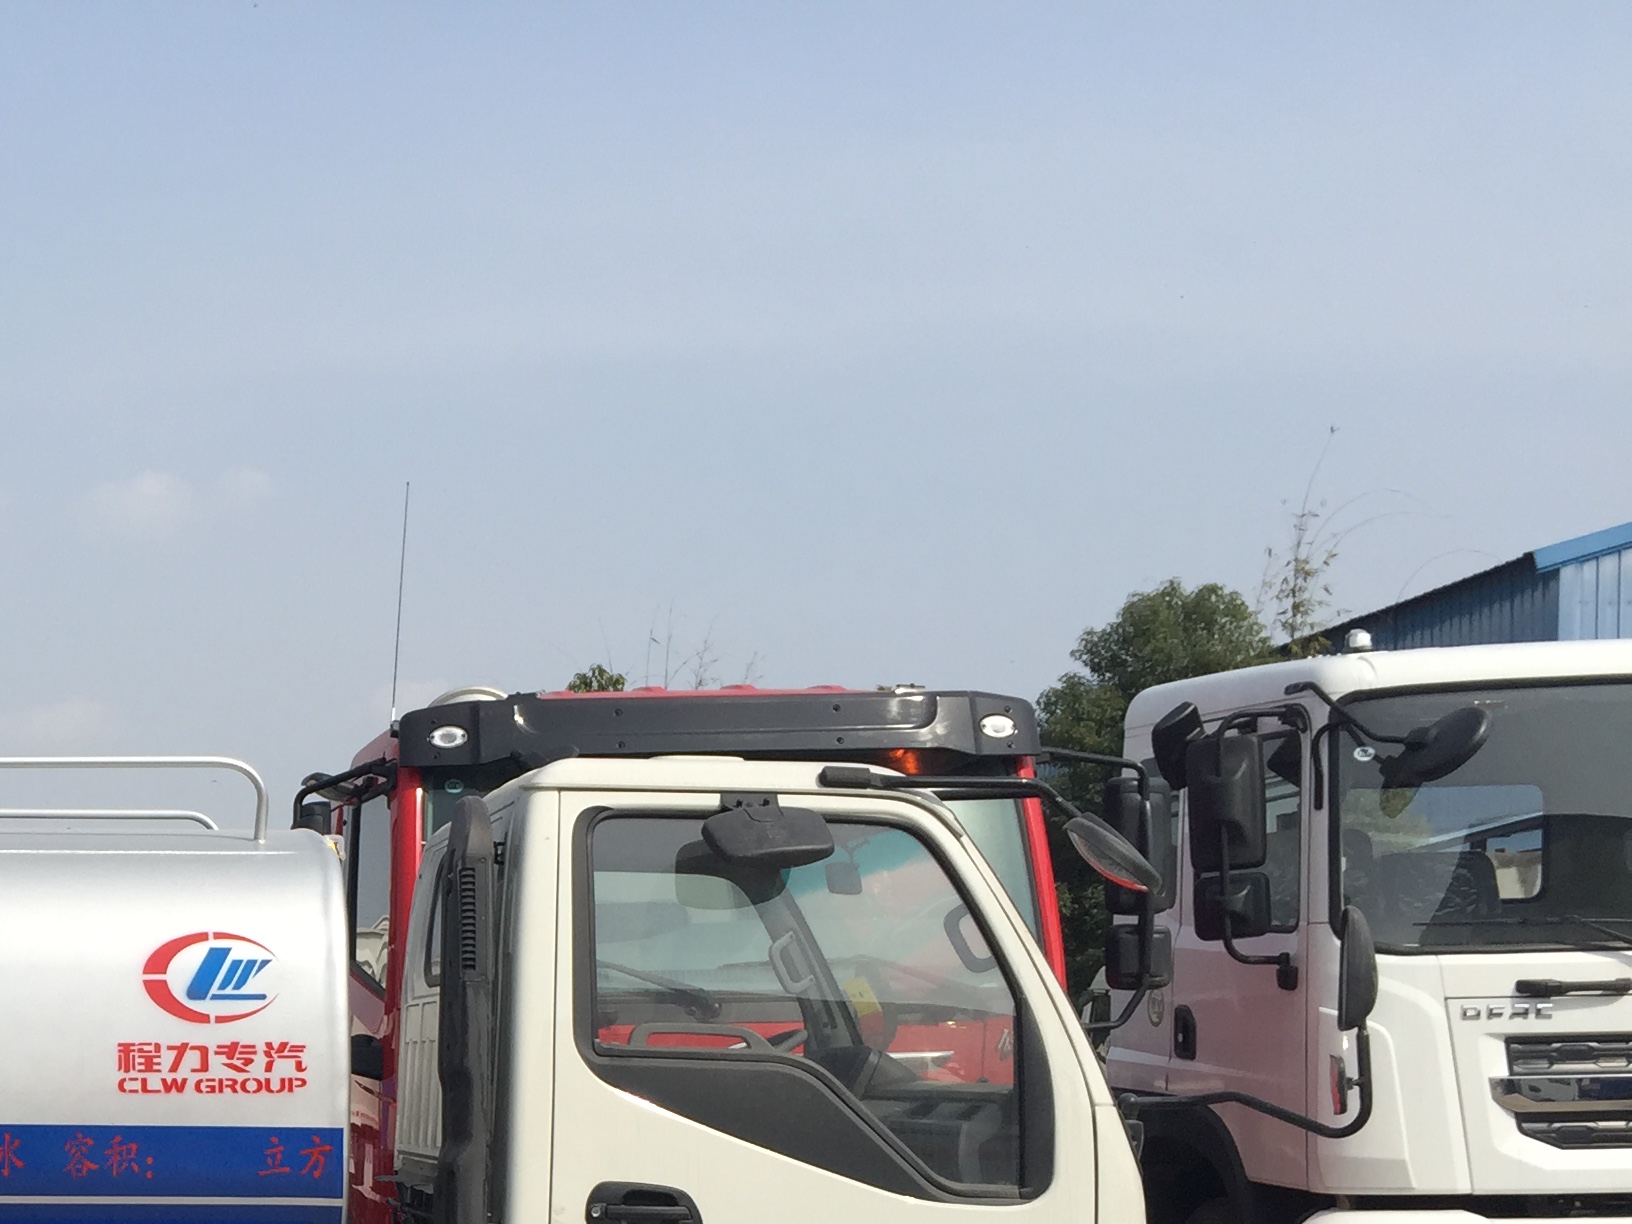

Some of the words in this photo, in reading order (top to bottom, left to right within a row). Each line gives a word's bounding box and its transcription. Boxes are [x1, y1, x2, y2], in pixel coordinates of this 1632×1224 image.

[116, 1041, 308, 1074] 程力专汽
[117, 1077, 188, 1094] CLW
[194, 1077, 307, 1094] GROUP
[63, 1131, 155, 1180] 容积:
[257, 1135, 334, 1180] 立方
